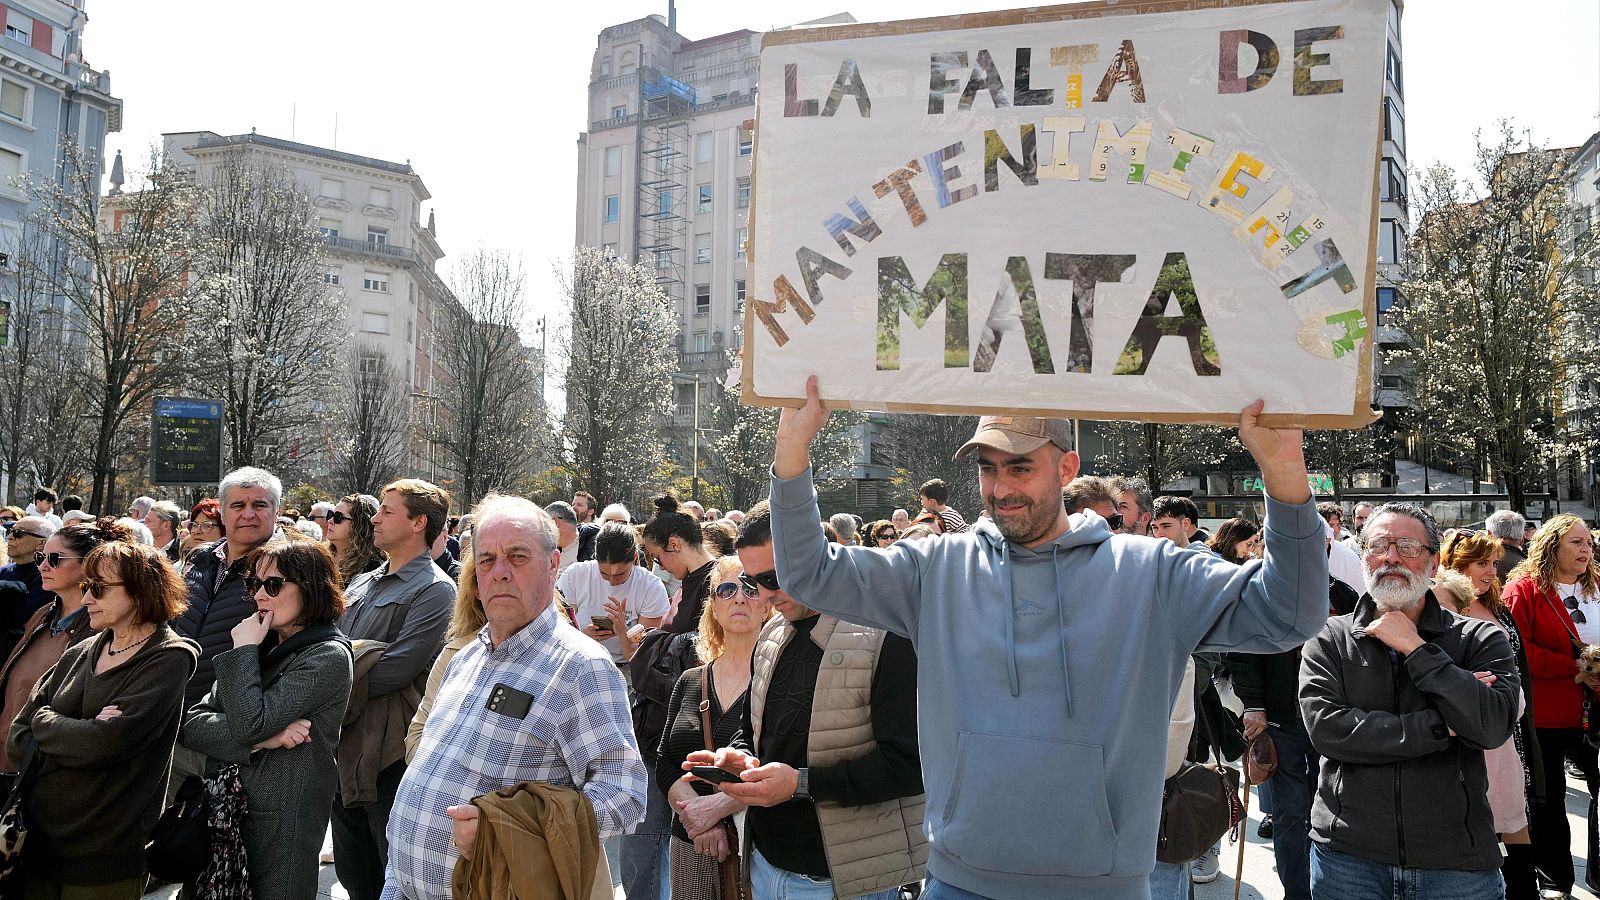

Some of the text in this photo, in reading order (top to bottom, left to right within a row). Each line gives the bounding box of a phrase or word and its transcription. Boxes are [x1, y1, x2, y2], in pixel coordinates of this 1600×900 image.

[784, 25, 1346, 118] LA FALTA DE
[752, 115, 1368, 360] MANTENIMIENTO
[1312, 218, 1325, 230] 15
[876, 251, 1222, 377] MATA
